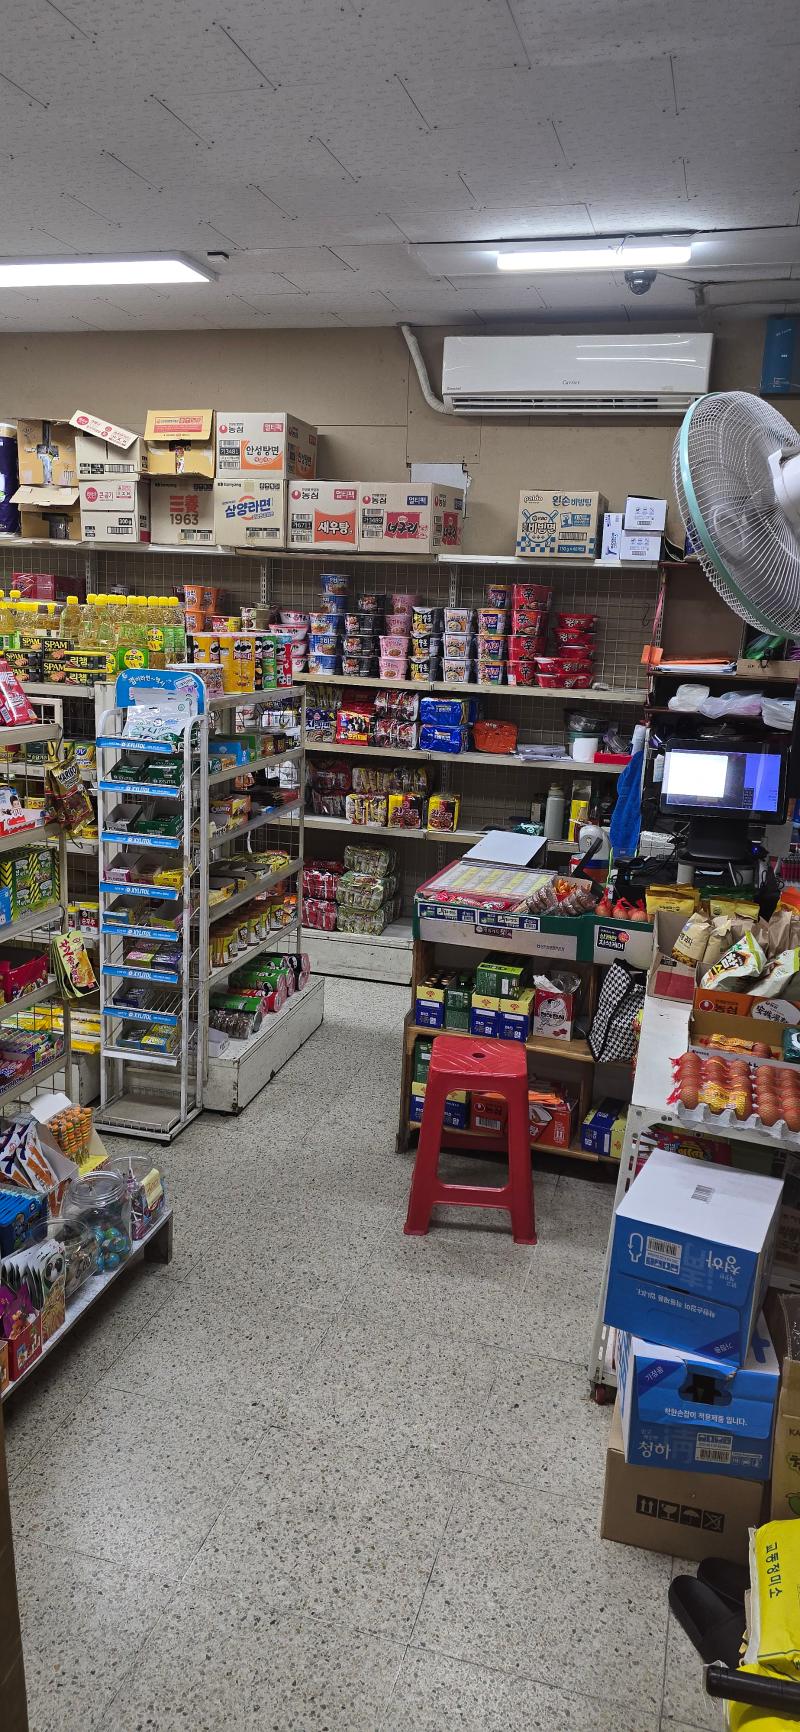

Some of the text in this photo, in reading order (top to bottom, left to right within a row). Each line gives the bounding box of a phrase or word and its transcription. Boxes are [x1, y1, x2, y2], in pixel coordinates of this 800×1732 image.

[228, 425, 244, 433] 농심
[246, 445, 279, 456] 안성탕면
[302, 490, 319, 499] 농심
[523, 495, 543, 503] paldo
[371, 496, 387, 504] 농심
[225, 498, 271, 518] 삼양라면
[170, 513, 199, 526] 1963
[317, 520, 350, 535] 새우탕
[387, 521, 418, 534] 너구리
[22, 637, 40, 645] SPAM
[44, 641, 68, 649] SPAM
[6, 652, 24, 660] SPAM
[70, 656, 88, 666] 리챔
[43, 662, 66, 671] SPAM
[70, 673, 88, 682] 리챔
[133, 837, 152, 845] XYLITOL
[131, 887, 150, 895] XYLITOL
[133, 929, 152, 937] XYLITOL
[133, 971, 152, 979] XYLITOL
[133, 1013, 152, 1021] XYLITOL
[32, 1054, 55, 1071] mentos
[706, 1250, 742, 1276] 청하
[645, 1366, 665, 1382] 가정용
[664, 1408, 748, 1426] 착한손잡이 적용제품 입니다.
[638, 1441, 672, 1460] 청하
[766, 1541, 783, 1599] 교동정미소
